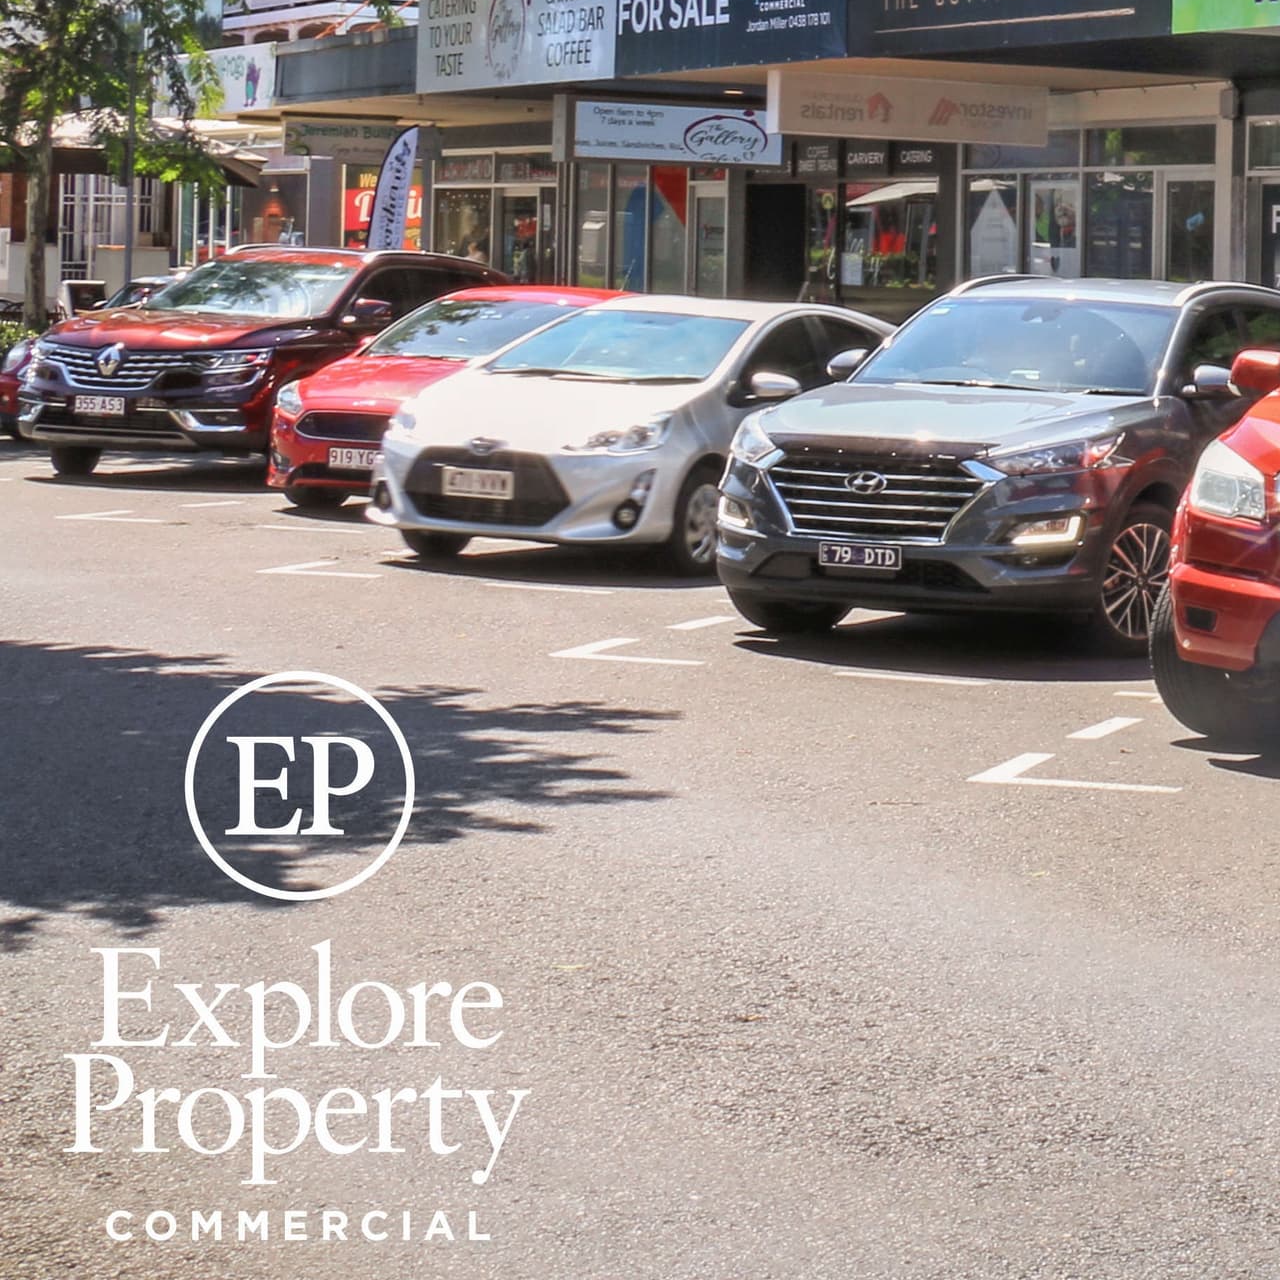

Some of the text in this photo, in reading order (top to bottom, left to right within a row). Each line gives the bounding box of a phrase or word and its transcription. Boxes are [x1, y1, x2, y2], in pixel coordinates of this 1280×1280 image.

[537, 6, 604, 36] SALAD BAR
[746, 18, 769, 32] Jordan
[770, 15, 788, 28] Miller
[430, 22, 472, 49] TO YOUR
[546, 39, 592, 67] COFFEE
[435, 52, 464, 77] TASTE
[690, 130, 758, 150] Gallery
[847, 151, 886, 166] CARVERY
[900, 149, 933, 164] CATERING
[75, 394, 96, 411] 355
[330, 448, 354, 466] 919
[831, 546, 895, 566] 79 DTD
